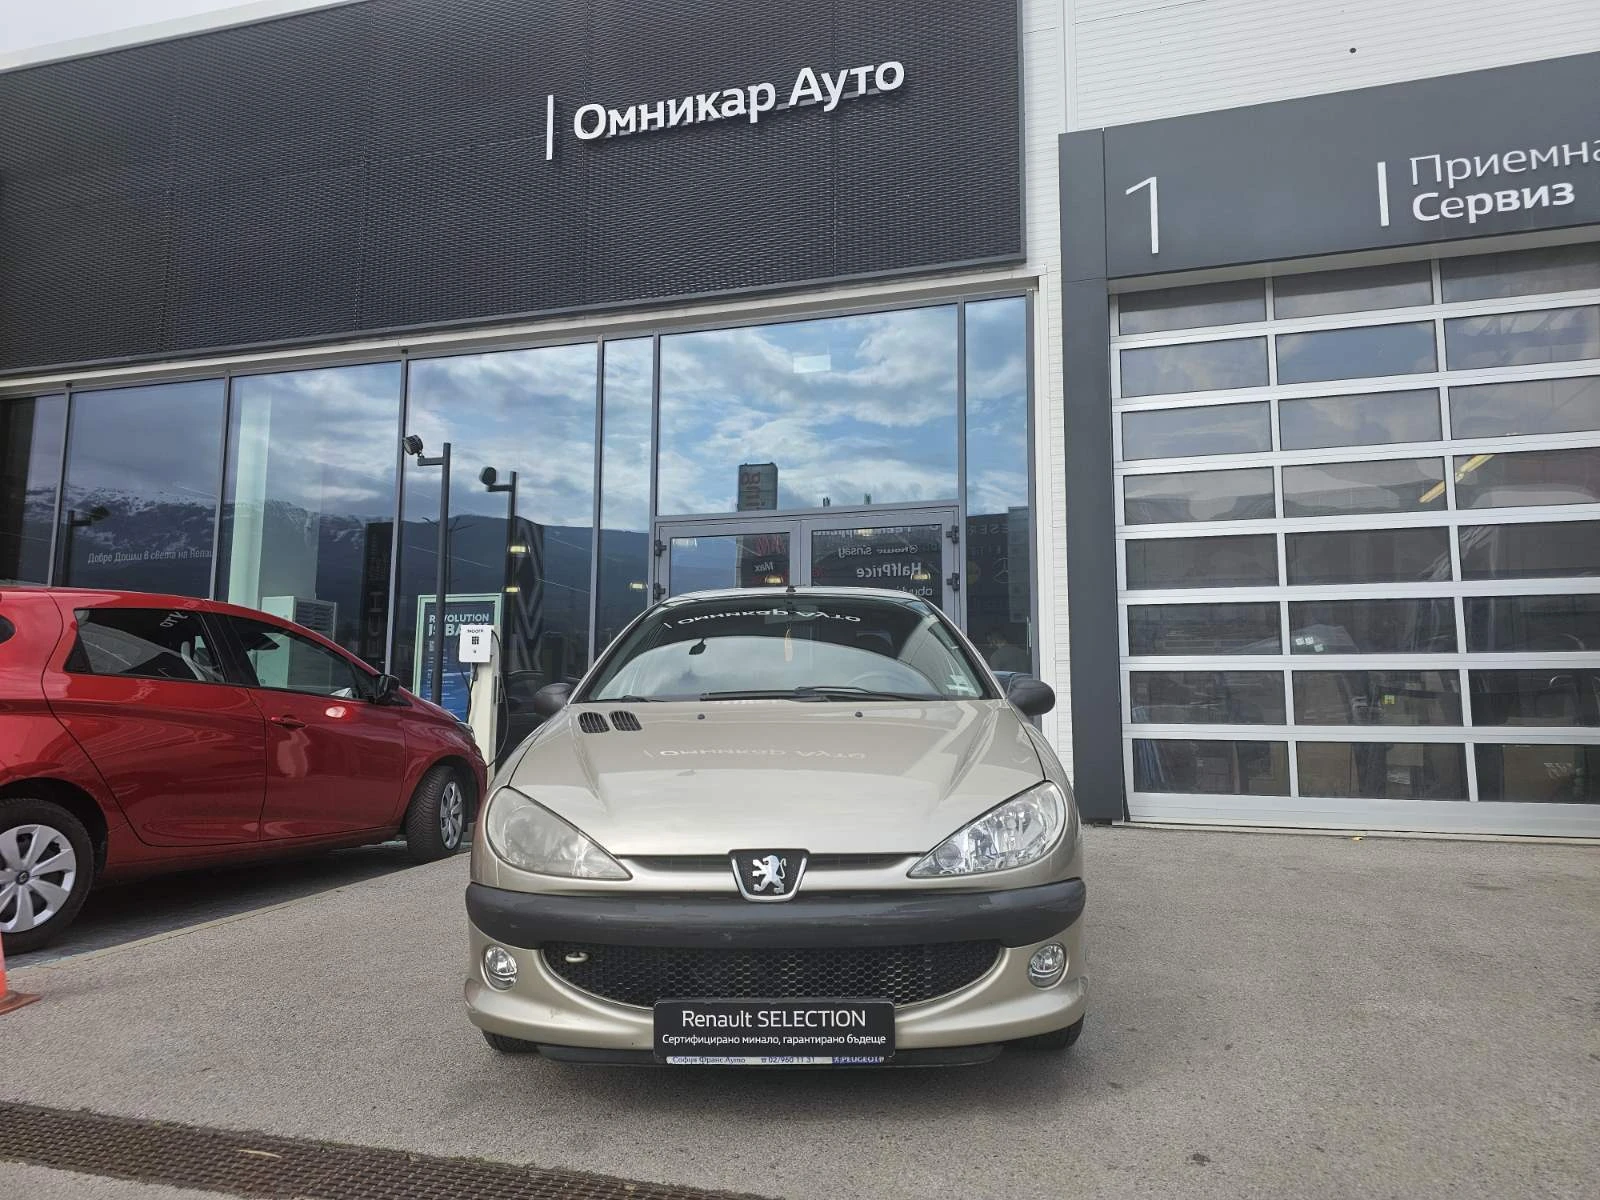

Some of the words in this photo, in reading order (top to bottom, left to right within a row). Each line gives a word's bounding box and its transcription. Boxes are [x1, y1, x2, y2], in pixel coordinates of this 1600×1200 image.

[573, 81, 776, 140] Омникар
[788, 61, 905, 112] Ауто
[1125, 176, 1159, 254] 1
[1412, 182, 1576, 224] Сервиз
[682, 1010, 752, 1028] Renault
[757, 1010, 866, 1027] SELECTION
[662, 1034, 740, 1047] Сертифицирано
[742, 1035, 781, 1046] минало,
[783, 1035, 844, 1045] гарантирано
[847, 1034, 887, 1046] бъдеще
